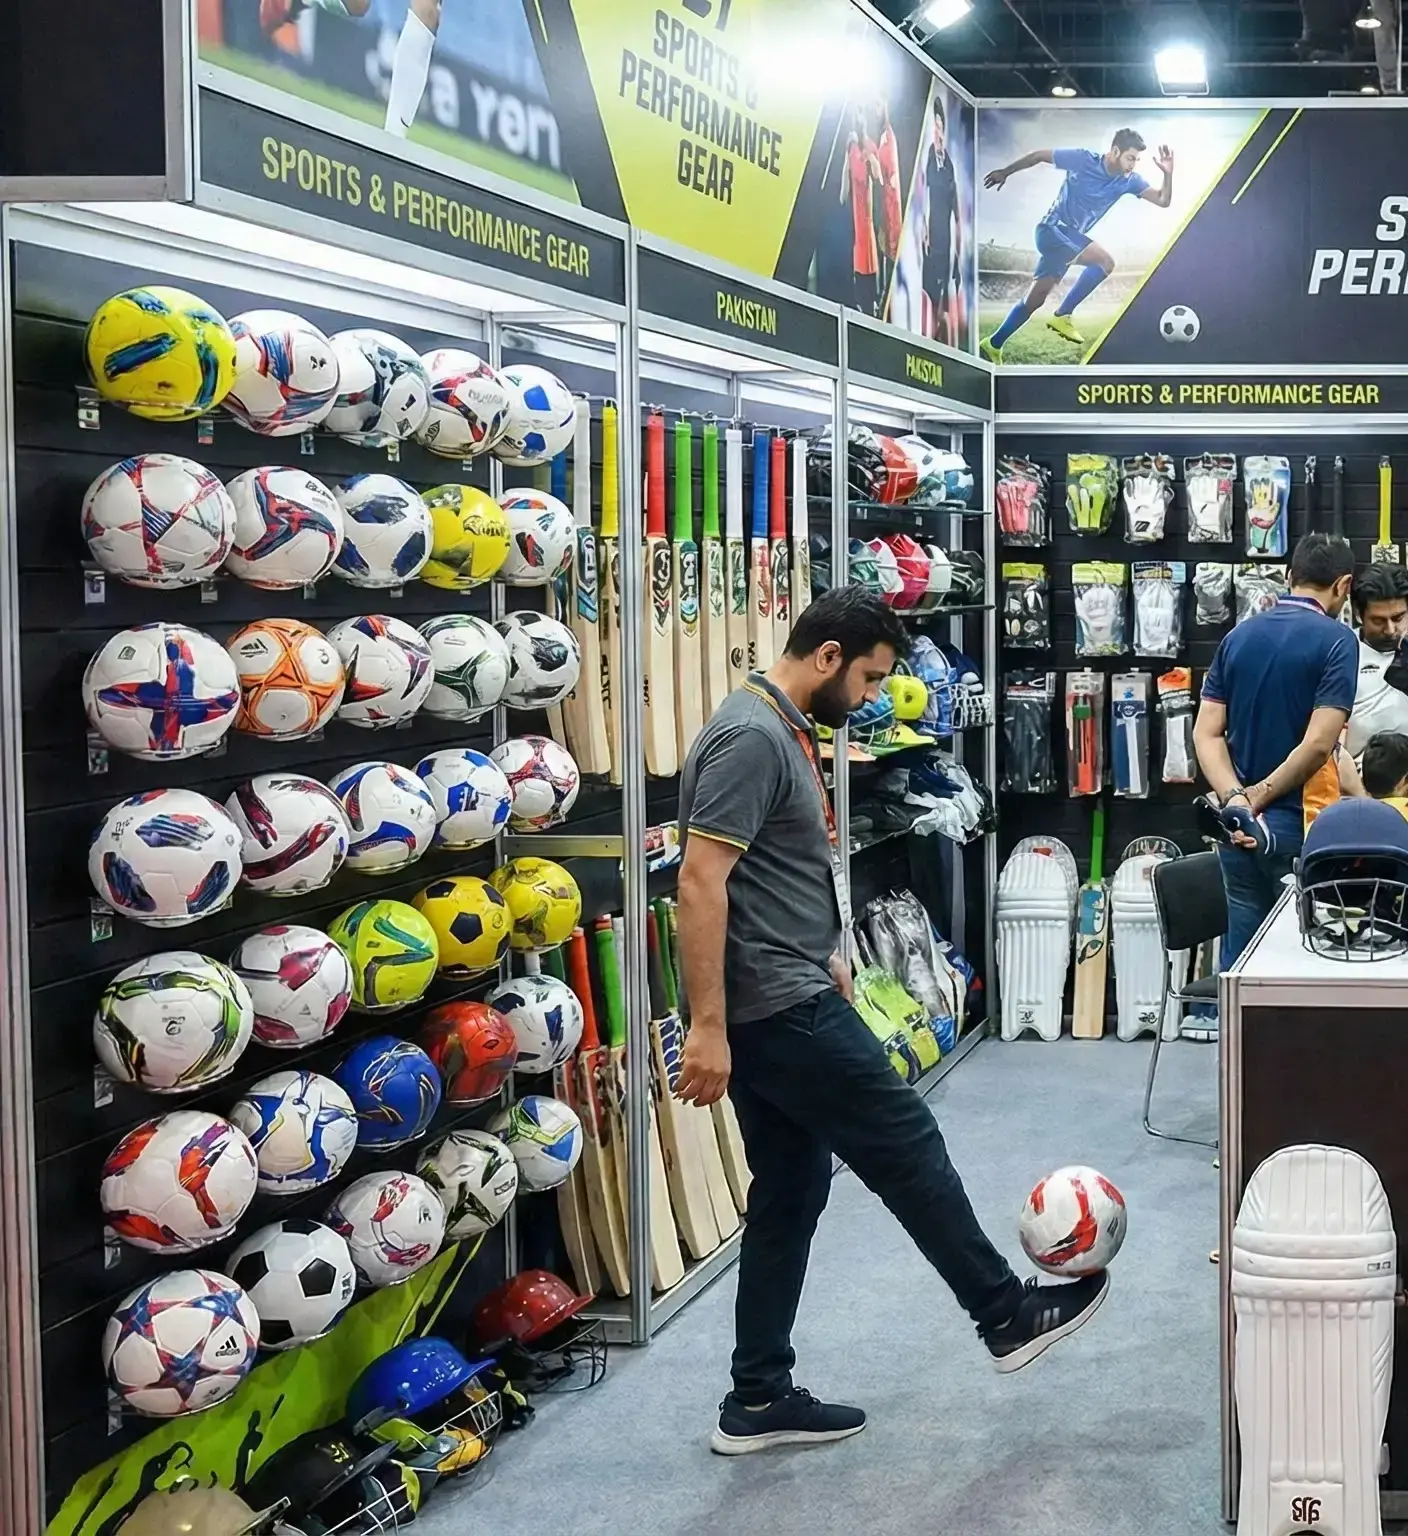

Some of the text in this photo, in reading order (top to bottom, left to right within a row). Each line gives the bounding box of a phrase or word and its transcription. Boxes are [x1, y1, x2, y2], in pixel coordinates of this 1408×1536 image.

[653, 9, 739, 101] SPORTS
[619, 48, 782, 176] PERFORMANCE
[262, 136, 590, 277] SPORTS & PERFORMANCE GEAR
[678, 139, 734, 206] GEAR
[717, 291, 777, 336] PAKISTAN
[1078, 384, 1380, 404] SPORTS & PERFORMANCE GEAR
